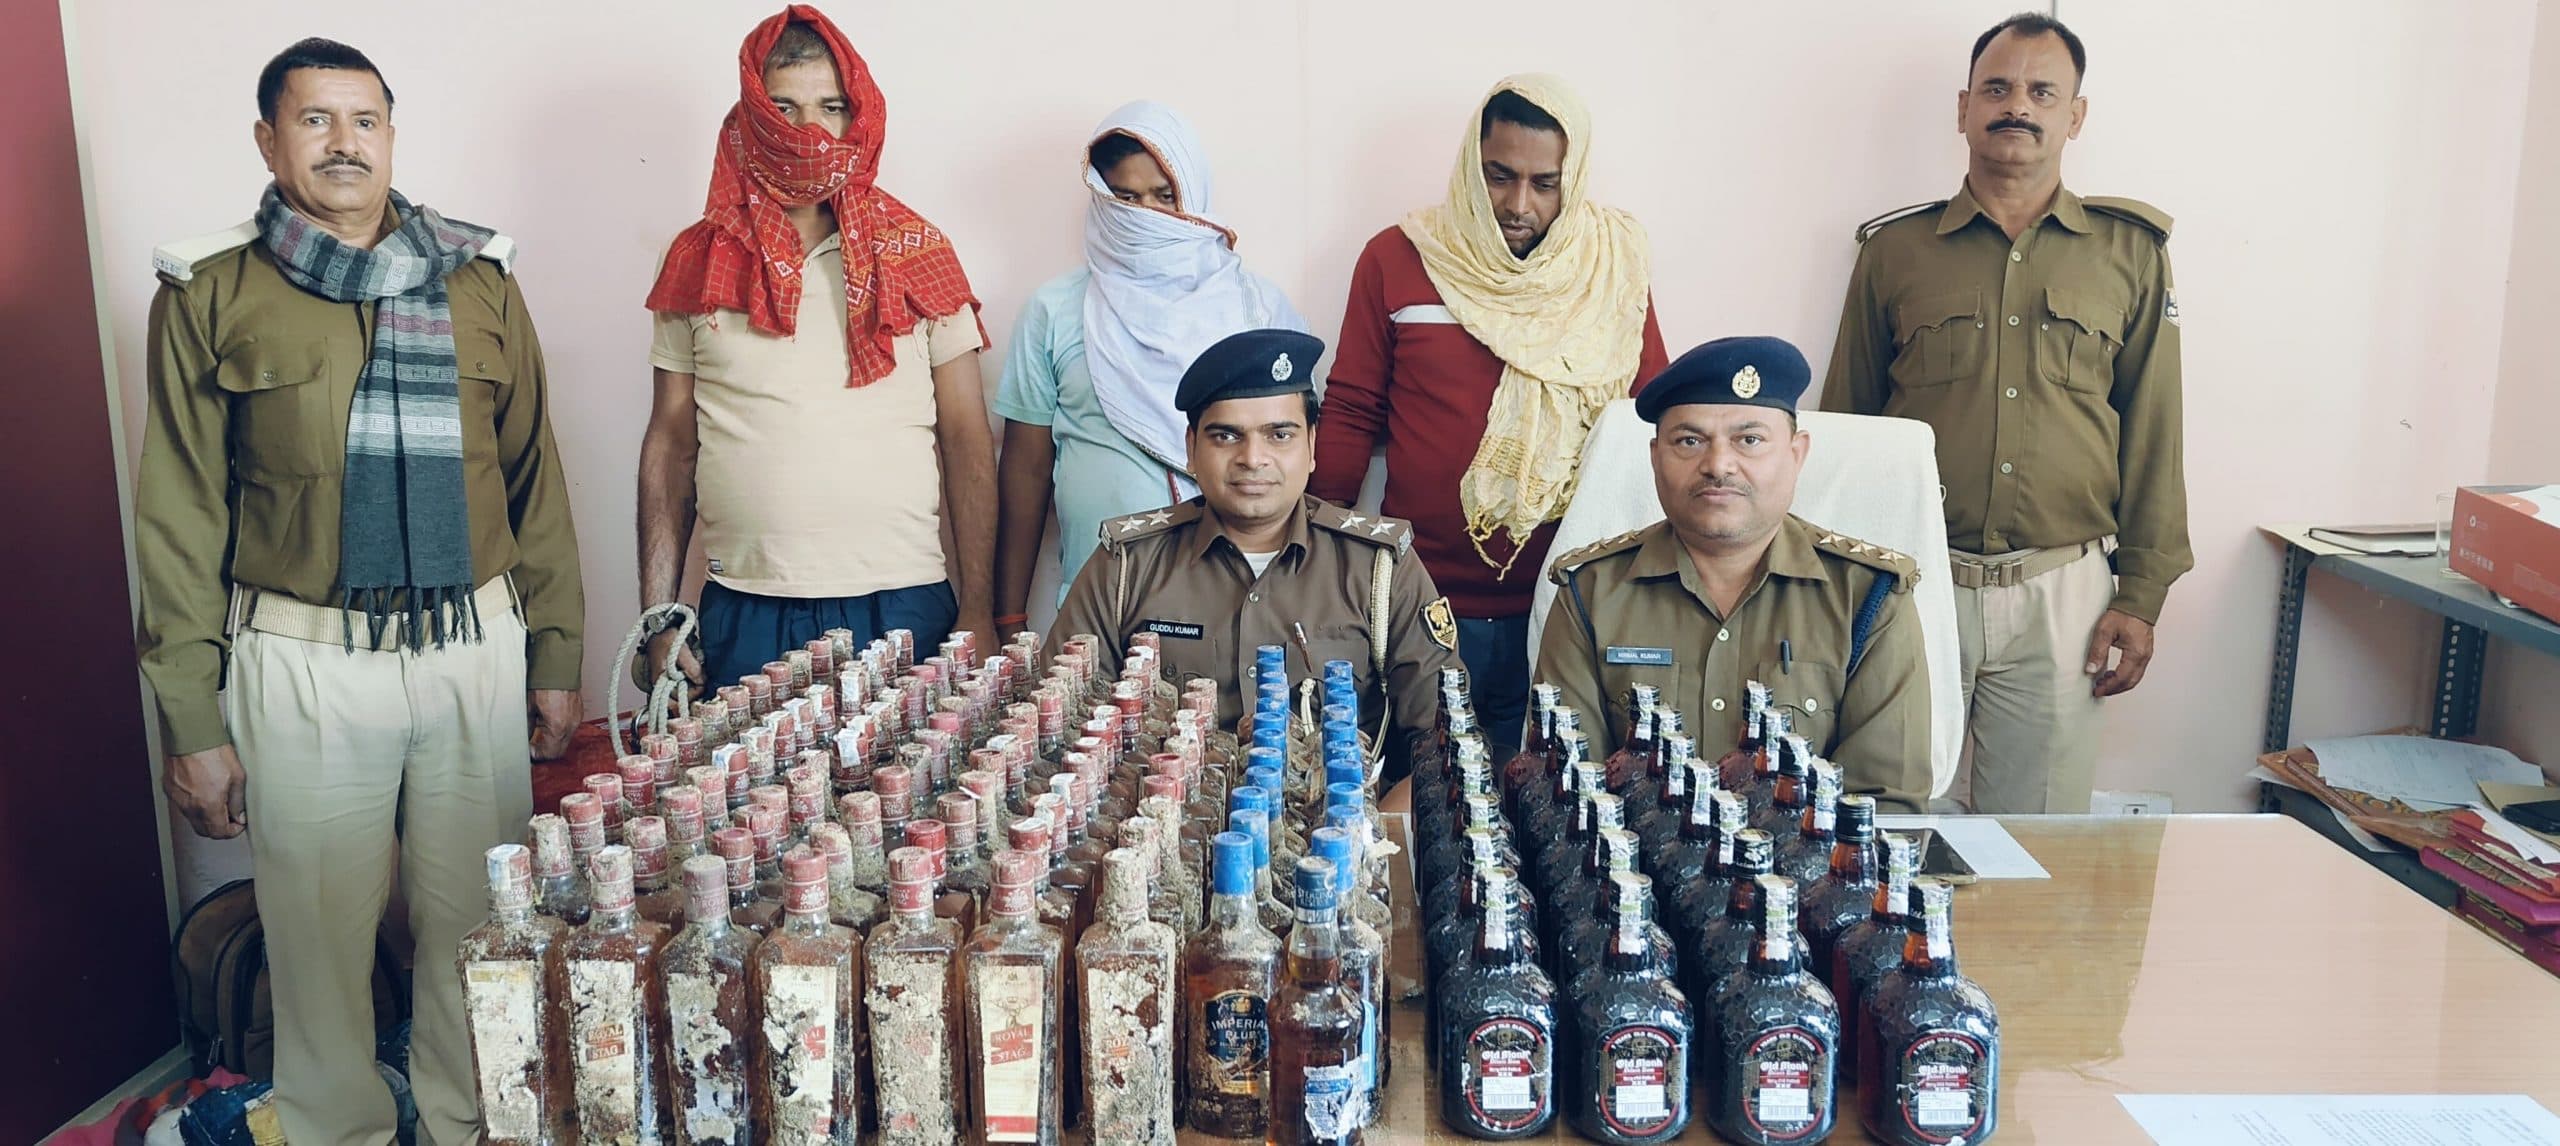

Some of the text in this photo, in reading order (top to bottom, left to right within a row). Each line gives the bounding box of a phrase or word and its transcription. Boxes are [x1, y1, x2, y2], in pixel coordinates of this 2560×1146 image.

[1150, 624, 1199, 635] GUDDU KUMAR
[994, 1028, 1028, 1042] ROYAL
[592, 1045, 618, 1060] STAG
[999, 1047, 1025, 1062] STAG
